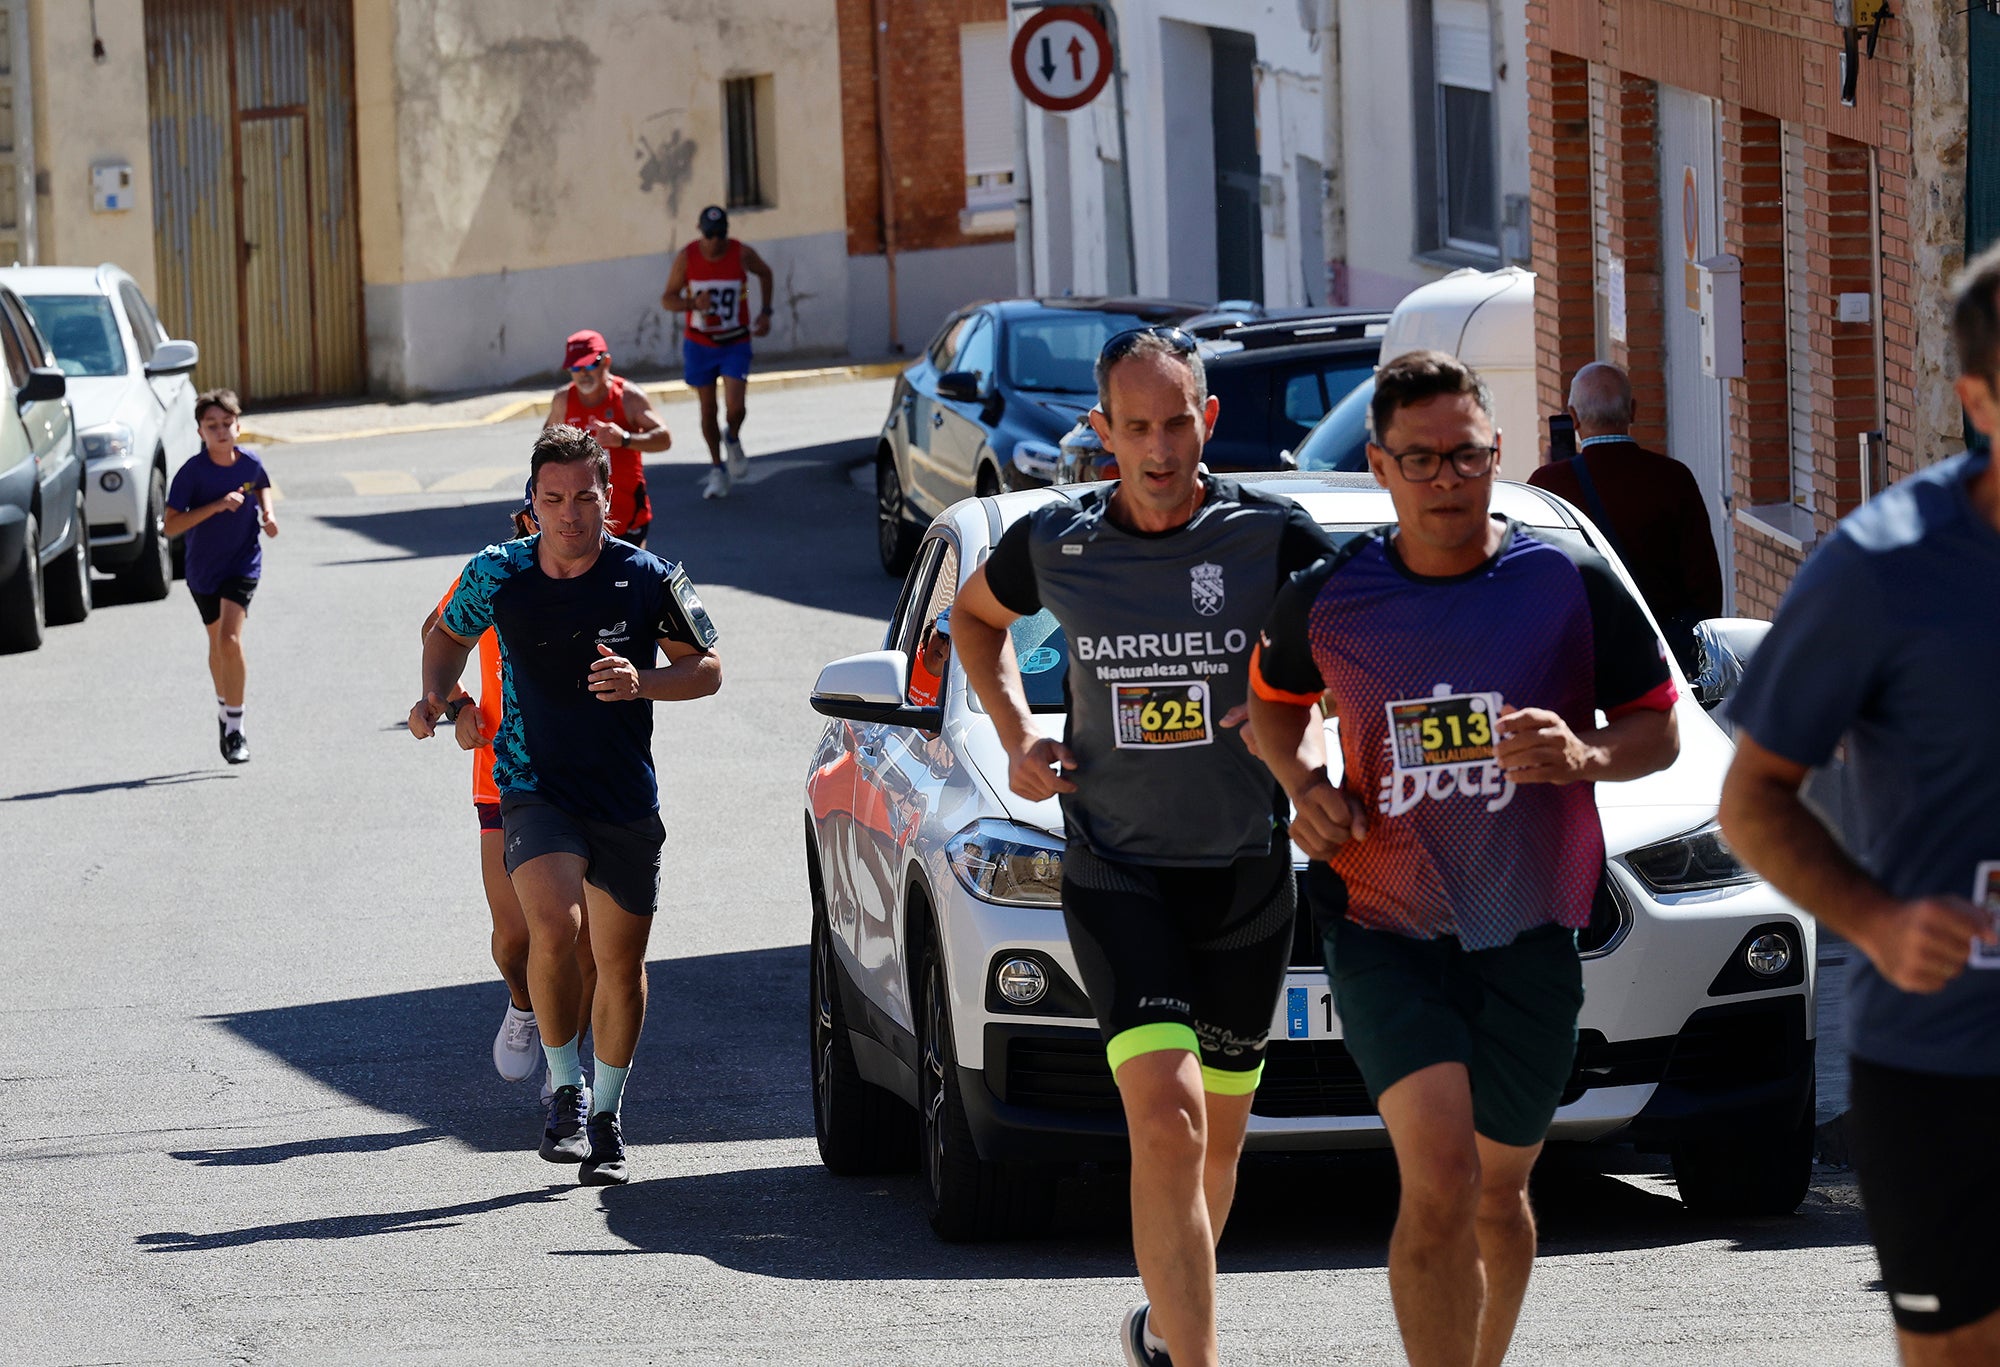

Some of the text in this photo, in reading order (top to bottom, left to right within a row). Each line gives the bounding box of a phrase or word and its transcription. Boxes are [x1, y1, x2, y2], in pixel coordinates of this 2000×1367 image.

[1077, 629, 1246, 660] BARRUELO
[1096, 660, 1229, 680] Naturaleza Viva
[1140, 700, 1203, 731] 625
[1422, 712, 1491, 750] 513
[1294, 1017, 1303, 1030] E
